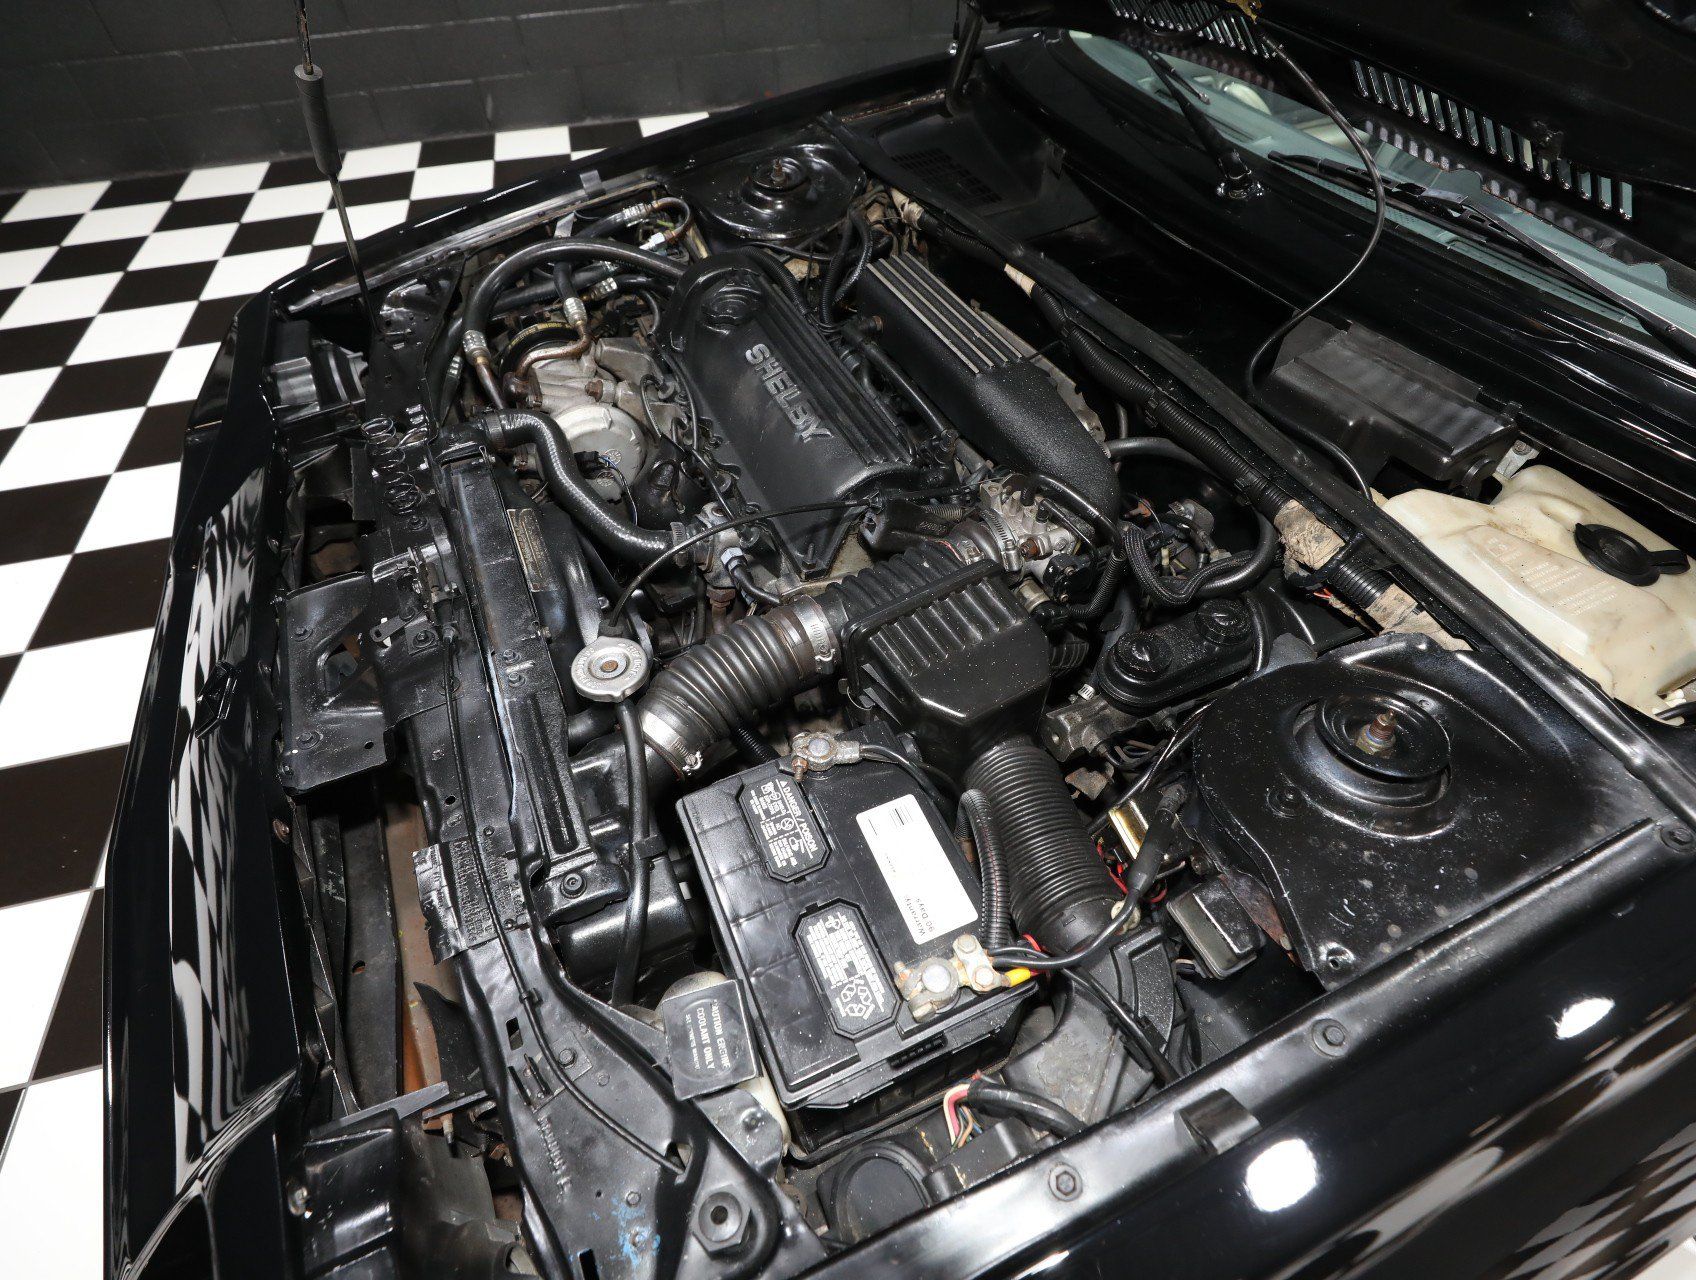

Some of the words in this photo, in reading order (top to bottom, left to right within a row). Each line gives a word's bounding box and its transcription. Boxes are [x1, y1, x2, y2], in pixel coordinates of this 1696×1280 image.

[745, 343, 834, 443] SHELBY
[783, 786, 802, 818] DANGER
[799, 822, 819, 852] POISON
[697, 1007, 711, 1045] COOLANT
[703, 1046, 716, 1070] ONLY
[717, 1037, 731, 1069] ENGINE
